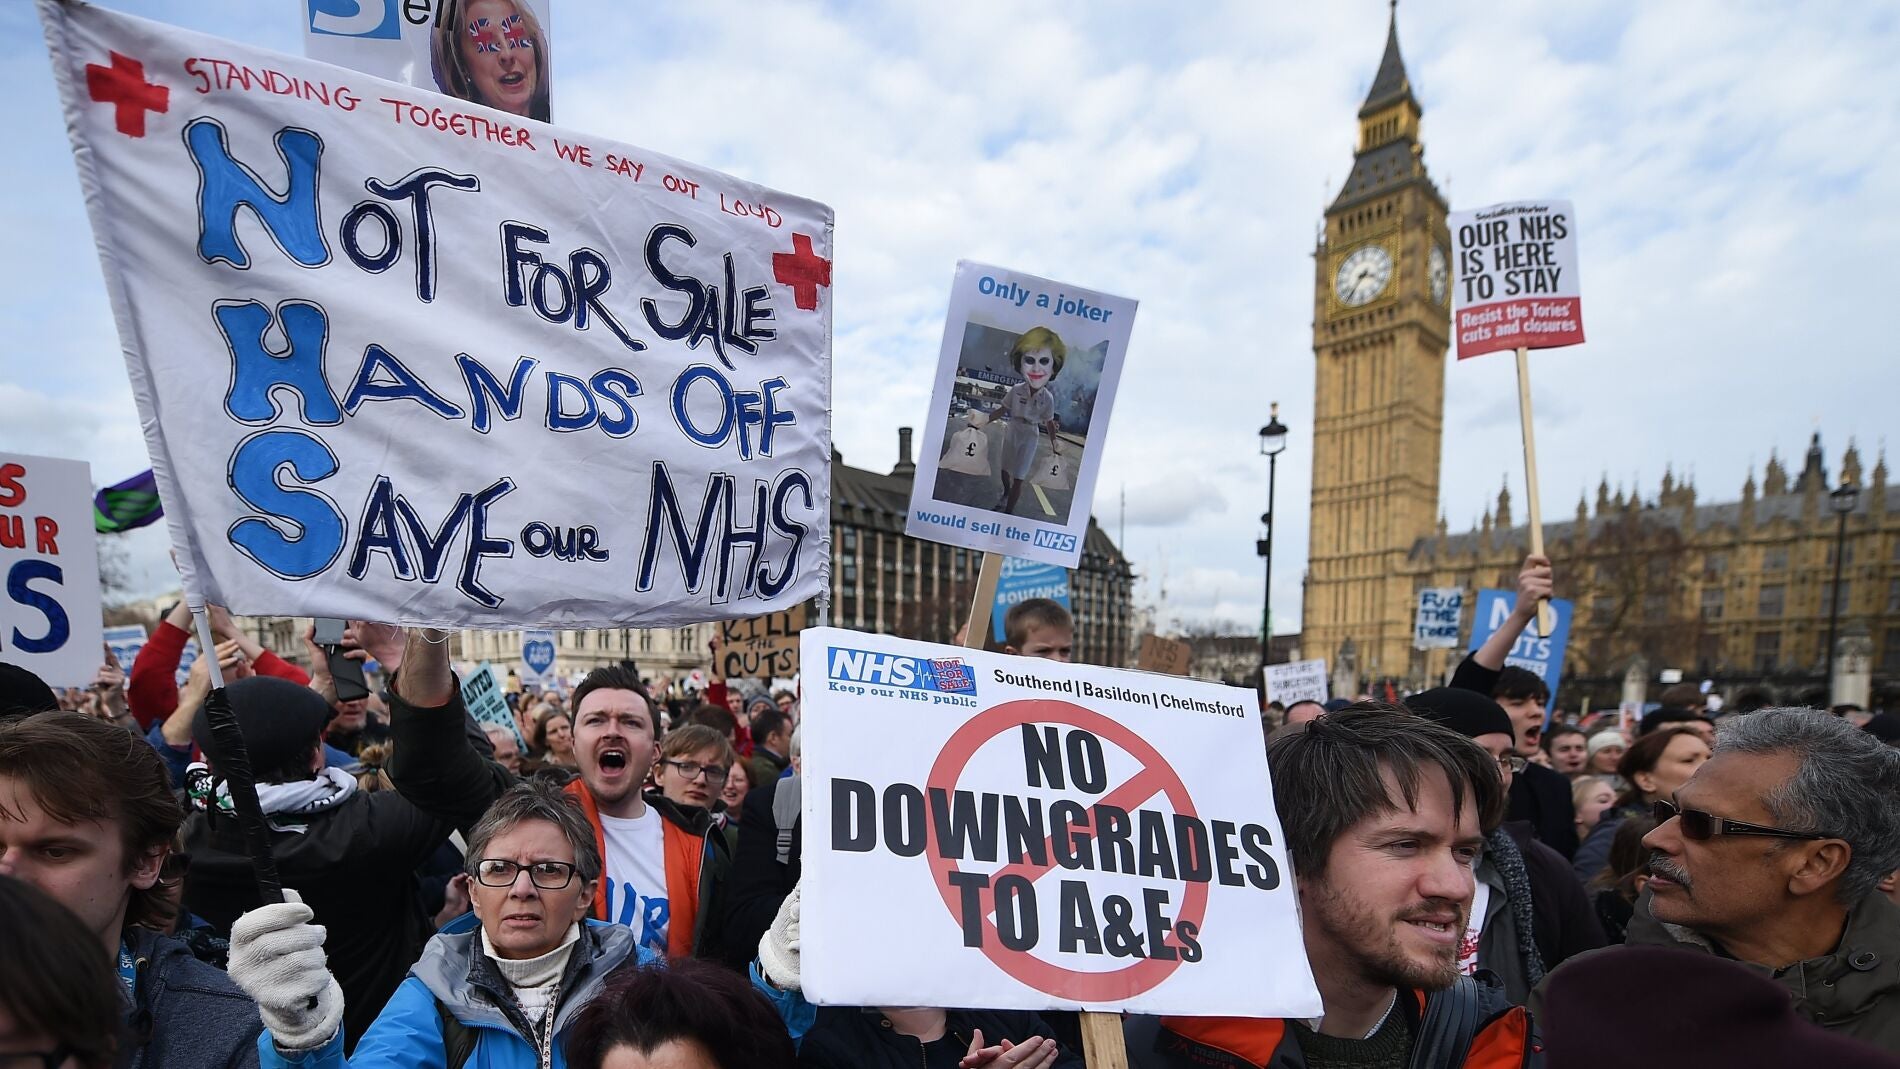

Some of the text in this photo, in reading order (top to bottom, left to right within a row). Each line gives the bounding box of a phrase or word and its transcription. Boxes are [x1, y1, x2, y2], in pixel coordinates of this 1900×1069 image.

[184, 57, 783, 228] STANDING TOGETHER WE SAY OUT LOUD
[182, 115, 777, 371] NOT FOR SALE
[1459, 213, 1568, 249] OUR NHS
[1460, 241, 1557, 276] IS HERE
[978, 276, 1113, 323] Only a joker
[1461, 267, 1562, 303] TO STAY
[1461, 307, 1503, 328] Resist
[1506, 304, 1529, 320] the
[1462, 325, 1492, 344] cuts
[1495, 320, 1520, 336] and
[1523, 318, 1578, 333] closures
[211, 298, 797, 461] HANDS OFF
[226, 425, 815, 610] SAVE OUR NHS
[916, 510, 1076, 552] would sell the NHS
[1488, 597, 1559, 638] NO
[830, 649, 917, 687] NHS
[933, 659, 961, 670] NOT
[939, 670, 964, 679] FOR
[463, 669, 493, 706] ANTED
[828, 681, 978, 709] Keep our NHS public
[939, 679, 972, 691] SALE
[994, 668, 1246, 719] Southend Basildon Chelmsford
[1021, 722, 1108, 795] NO
[830, 777, 1281, 891] DOWNGRADES
[948, 870, 1040, 953] TO
